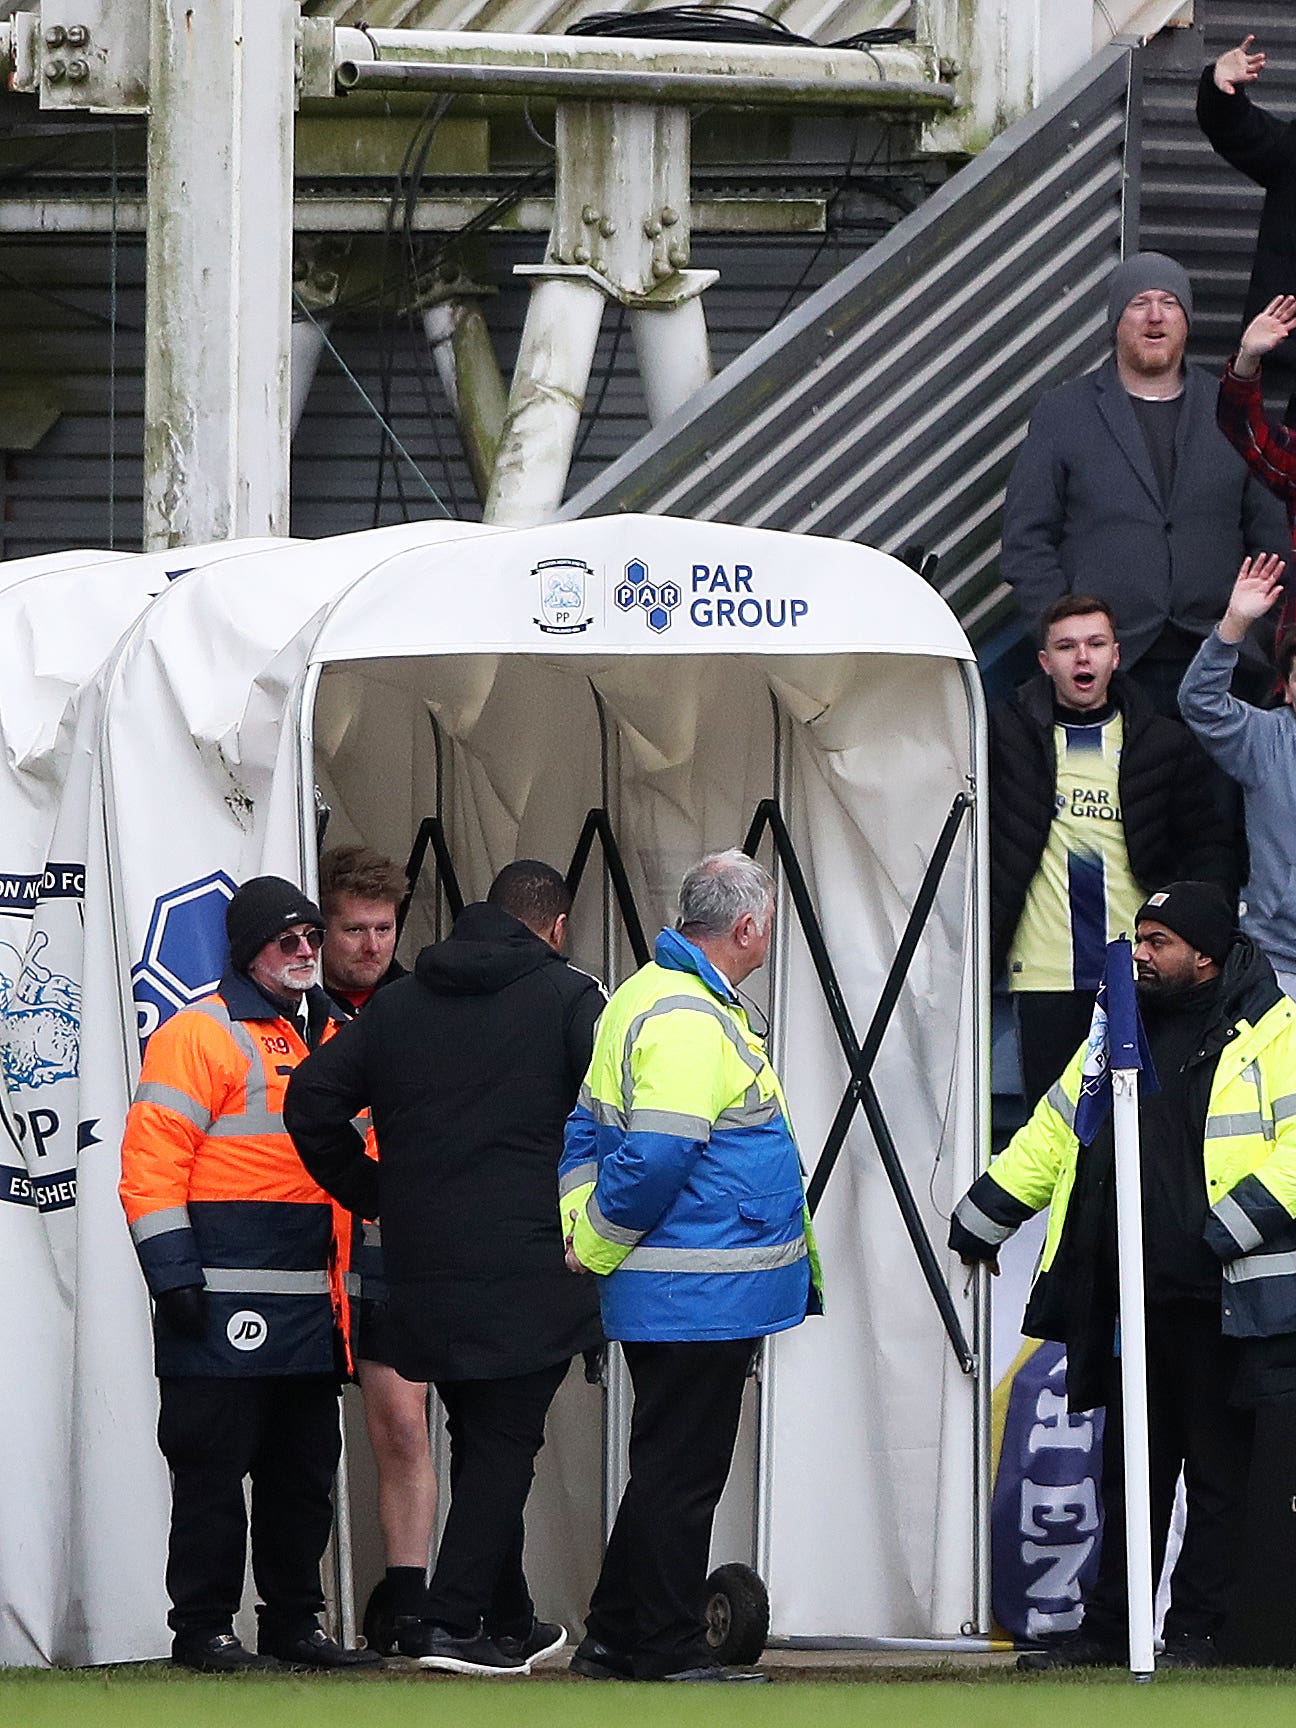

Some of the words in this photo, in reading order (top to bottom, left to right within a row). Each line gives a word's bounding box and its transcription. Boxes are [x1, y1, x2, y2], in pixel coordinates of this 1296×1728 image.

[691, 565, 754, 593] PAR
[619, 588, 676, 607] PAR
[690, 599, 809, 628] GROUP
[1073, 788, 1109, 805] PAR
[234, 1321, 262, 1341] JD
